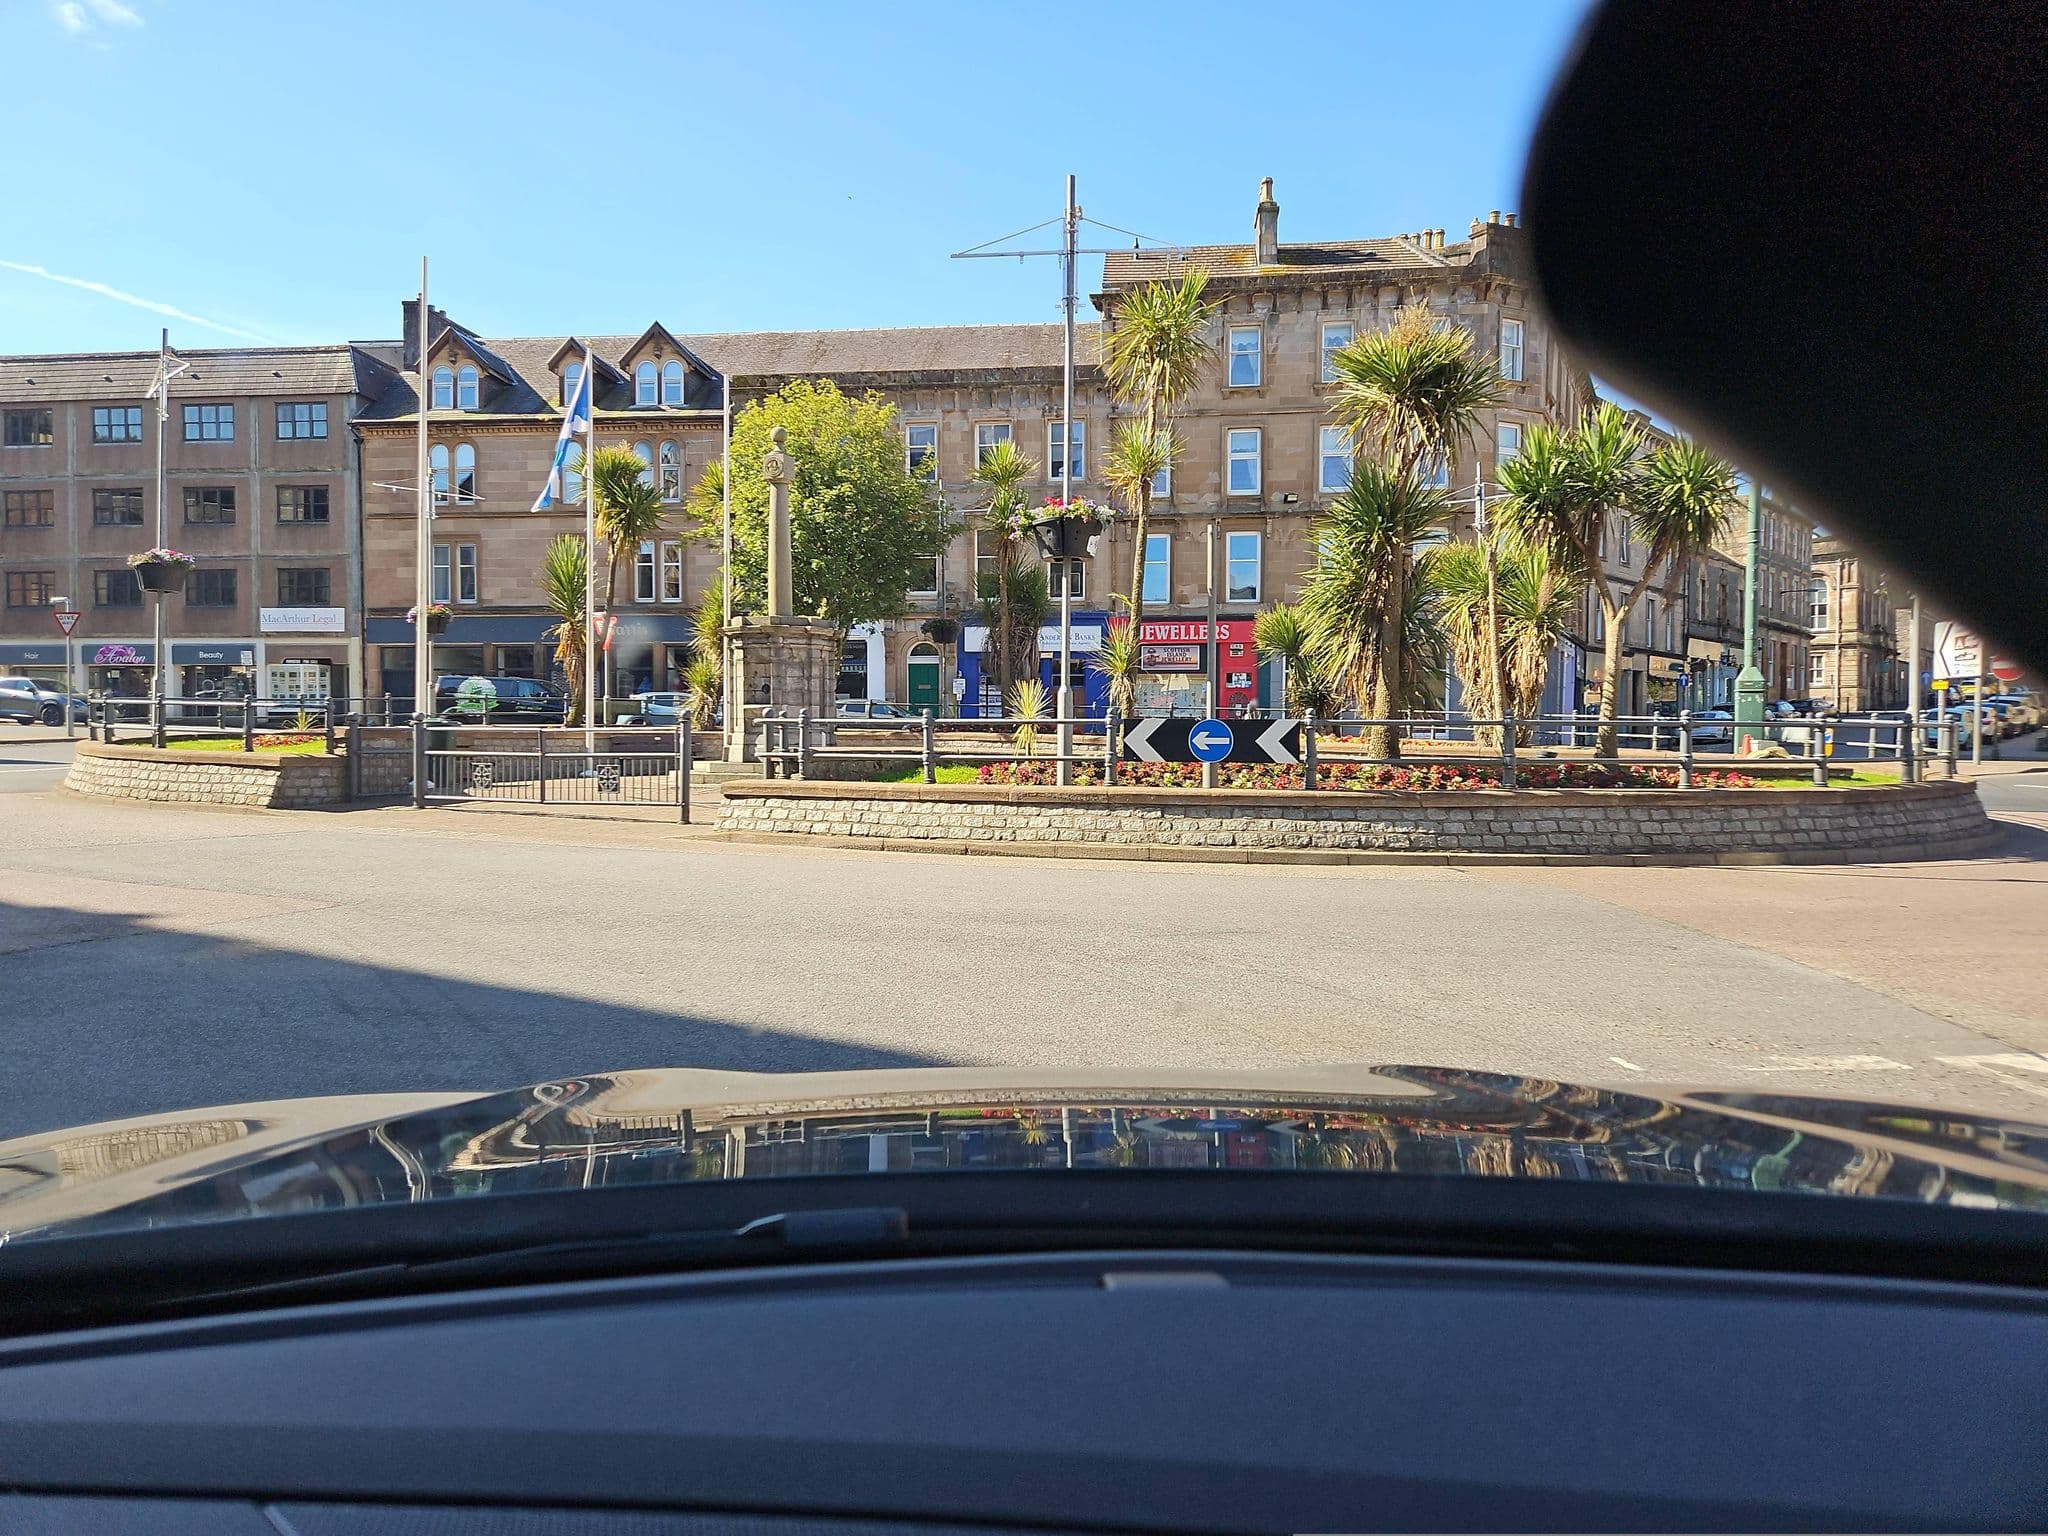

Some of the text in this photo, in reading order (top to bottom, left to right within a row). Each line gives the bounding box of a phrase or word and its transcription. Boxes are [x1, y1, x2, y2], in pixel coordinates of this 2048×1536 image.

[262, 613, 336, 625] MacArthur Legal
[24, 651, 40, 660] Hair
[94, 645, 147, 664] Avalon
[199, 651, 224, 660] Beauty
